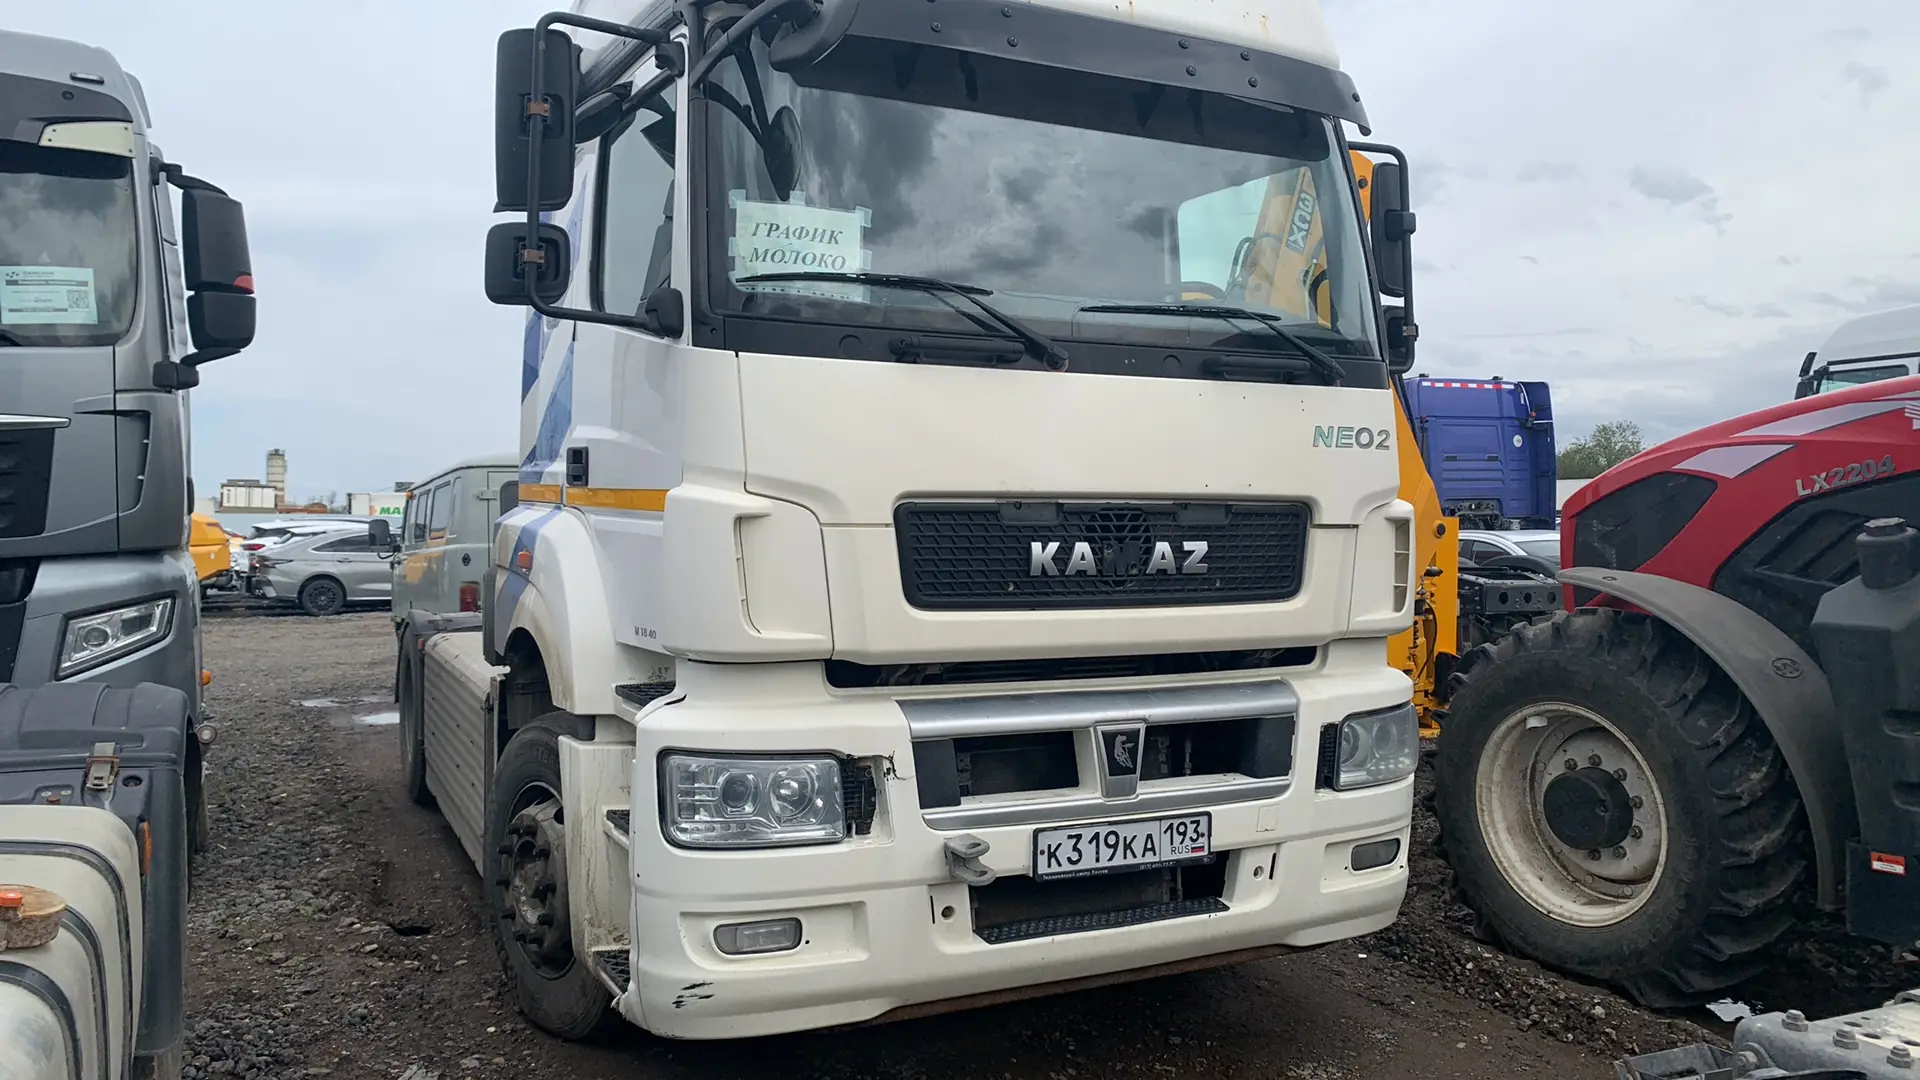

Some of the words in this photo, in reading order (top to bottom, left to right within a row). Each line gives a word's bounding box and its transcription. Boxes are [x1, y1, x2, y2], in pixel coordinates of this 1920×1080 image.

[752, 222, 842, 244] ГРАФИК
[749, 247, 846, 270] МОЛОКО
[1312, 425, 1391, 450] NEO2
[1796, 454, 1895, 496] LX2204
[379, 506, 404, 515] MA
[1163, 819, 1201, 847] 193
[1046, 830, 1157, 869] К319КА
[1170, 844, 1191, 856] RUS
